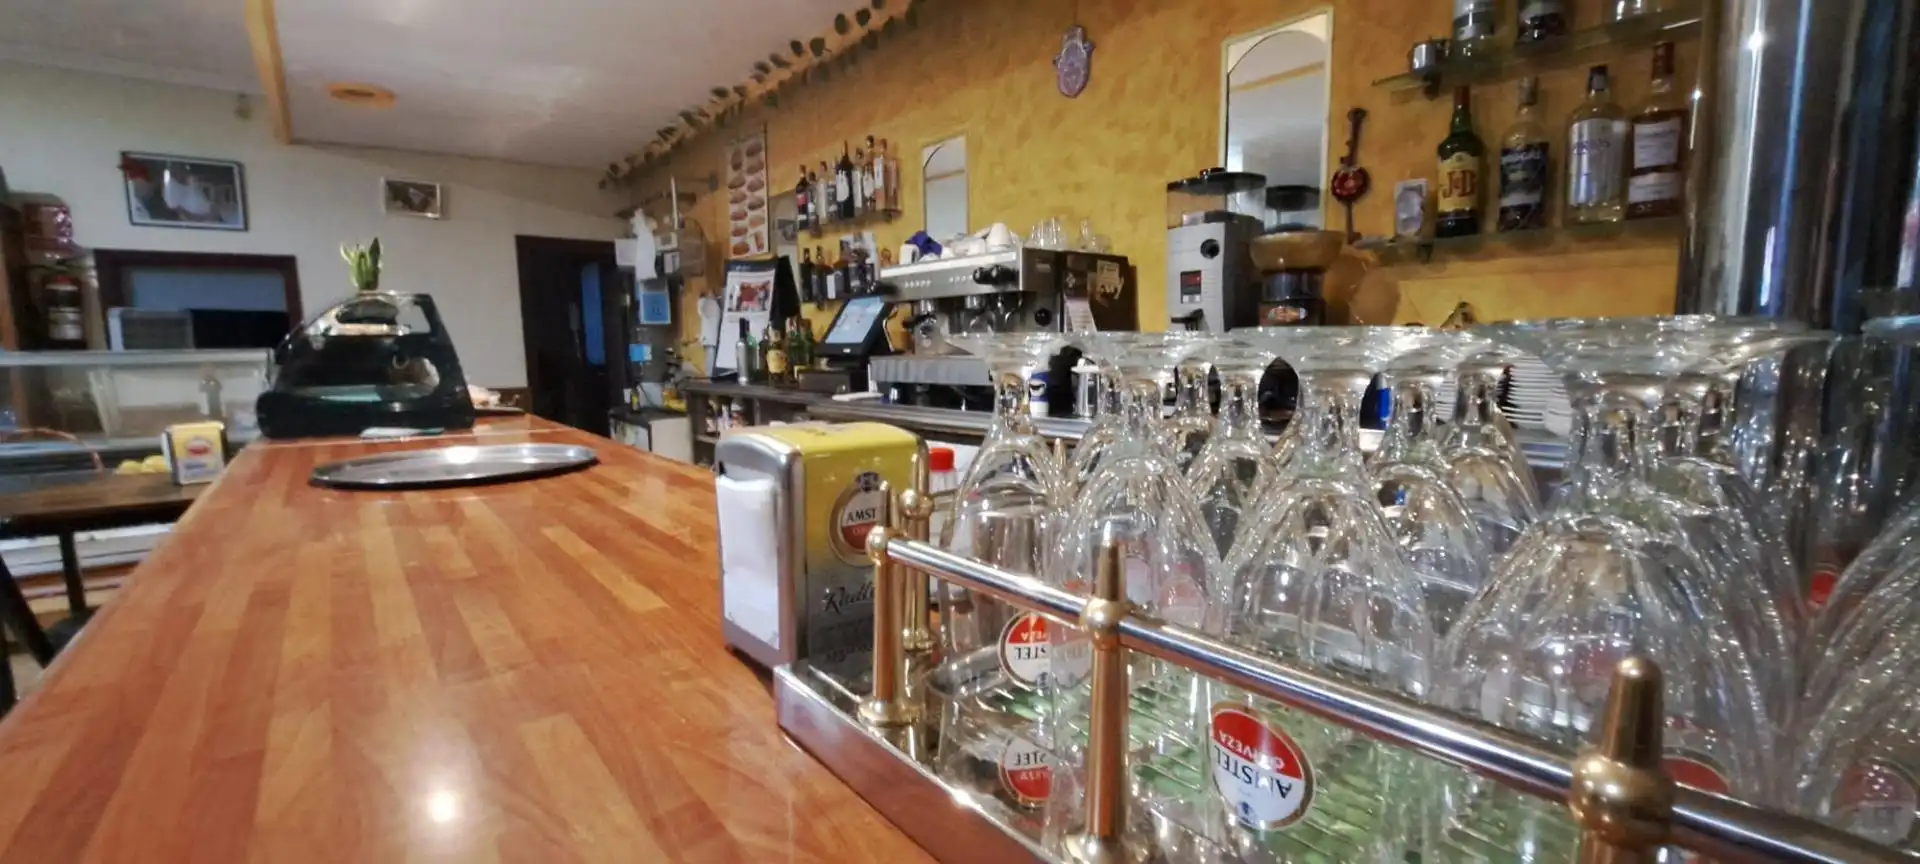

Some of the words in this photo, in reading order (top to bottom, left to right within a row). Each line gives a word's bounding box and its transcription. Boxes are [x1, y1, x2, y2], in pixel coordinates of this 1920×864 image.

[846, 507, 877, 525] AMST
[1014, 646, 1047, 661] STEL
[1219, 729, 1284, 770] CVEZA
